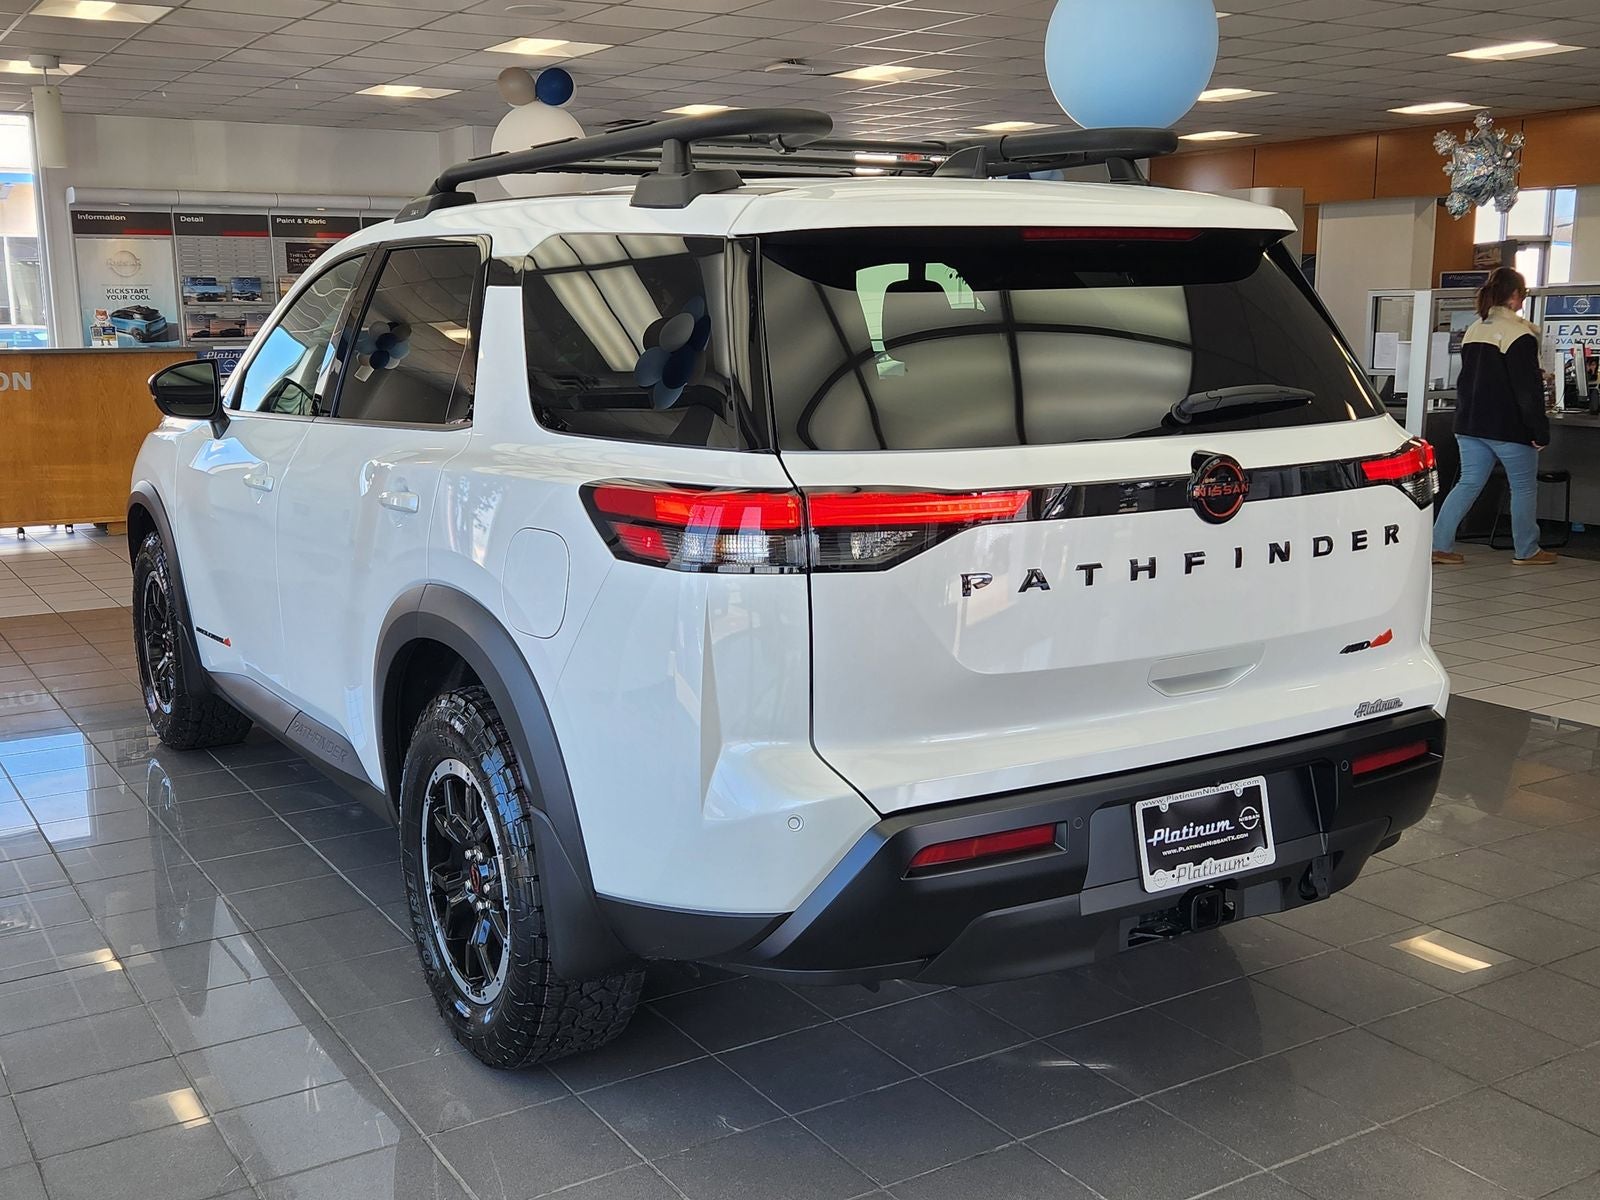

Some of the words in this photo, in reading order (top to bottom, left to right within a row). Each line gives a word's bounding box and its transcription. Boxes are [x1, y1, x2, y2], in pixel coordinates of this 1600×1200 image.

[77, 213, 126, 221] Information
[1193, 483, 1249, 497] NISSAN
[960, 523, 1401, 597] PATHFINDER
[1354, 698, 1404, 718] Platinum
[1140, 778, 1260, 808] www.PlatinumNissanTX.com
[1238, 812, 1261, 823] NISSAN
[1146, 819, 1235, 847] Platinum
[1175, 858, 1250, 884] Platinum
